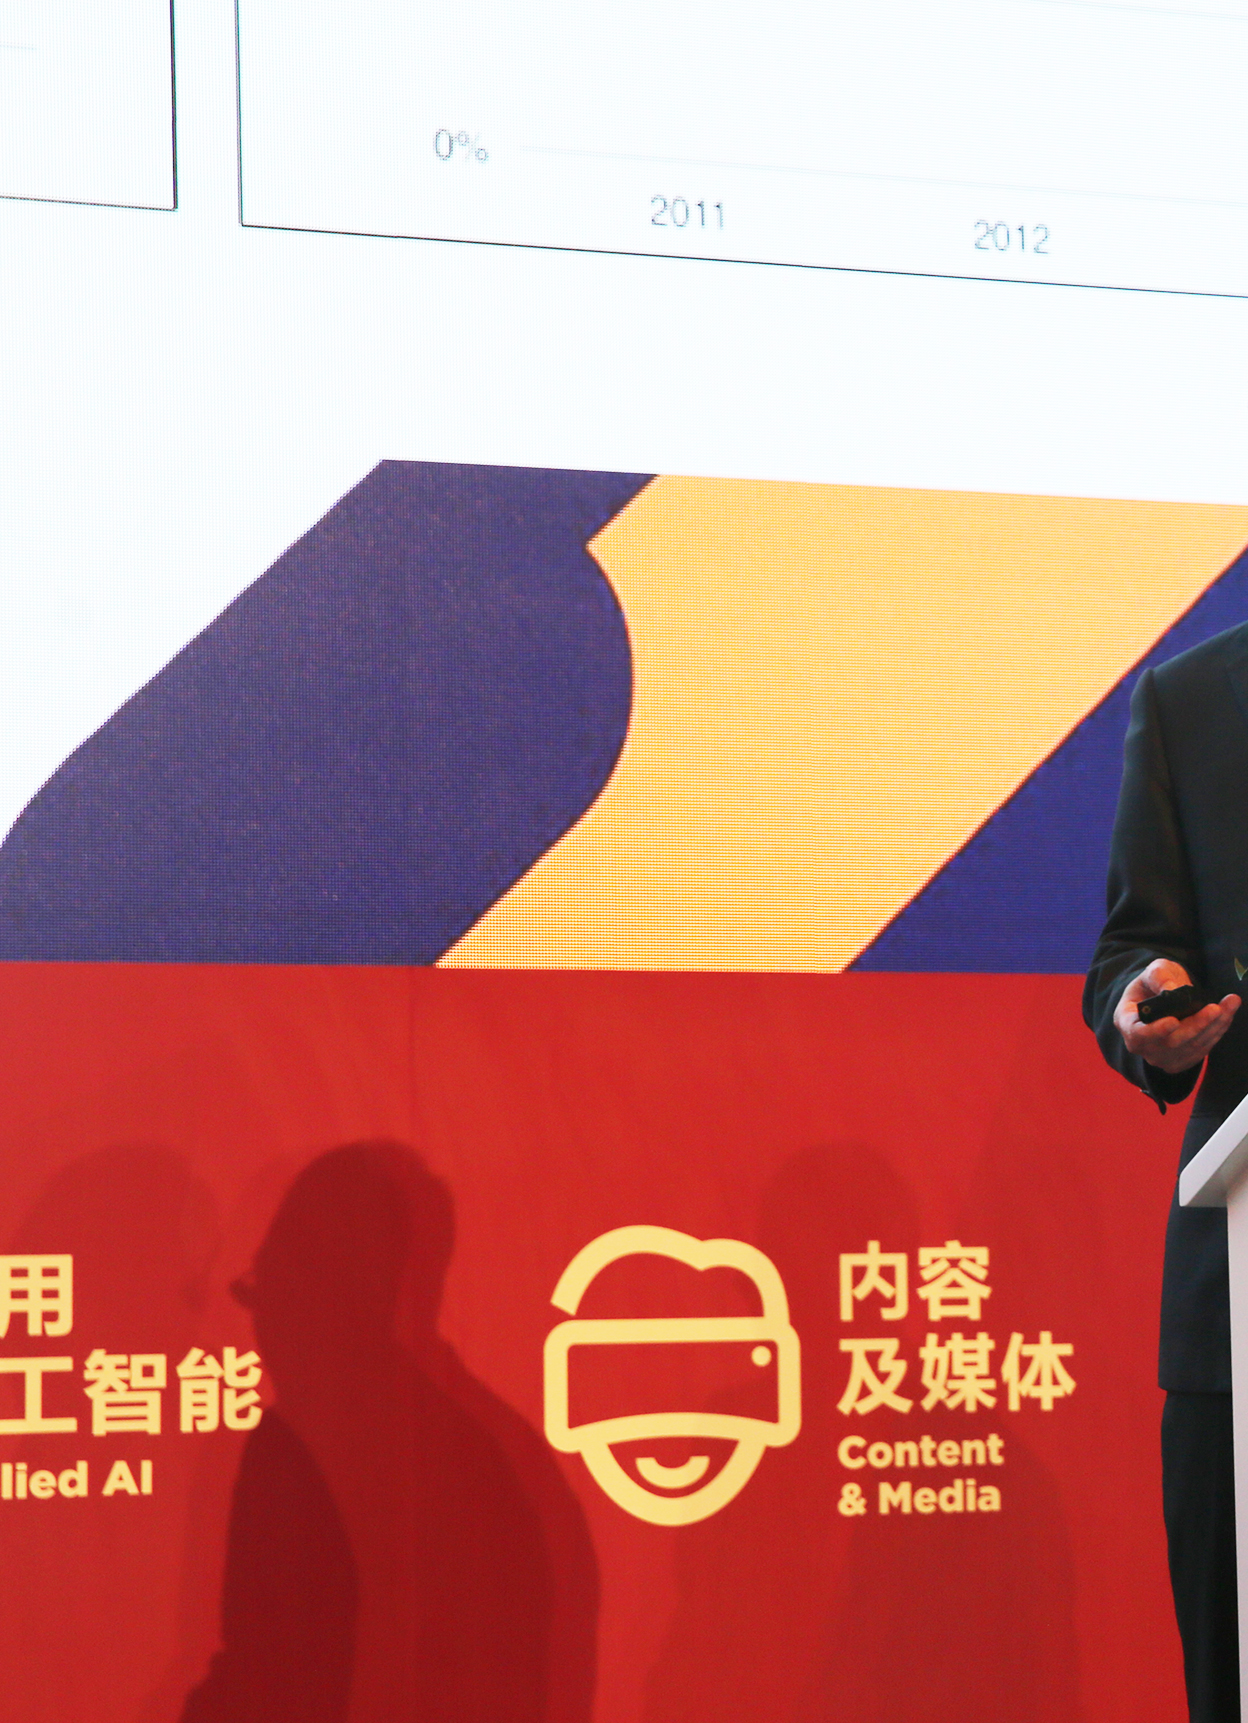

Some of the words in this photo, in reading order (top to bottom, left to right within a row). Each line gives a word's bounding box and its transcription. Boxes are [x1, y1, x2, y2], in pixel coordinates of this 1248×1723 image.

[433, 129, 491, 165] 0%
[650, 195, 726, 231] 2011
[974, 219, 1051, 257] 2012
[0, 1253, 74, 1339] 用
[838, 1239, 993, 1323] 内容
[0, 1346, 263, 1437] 工智能
[836, 1330, 1077, 1416] 及媒体
[0, 1460, 89, 1501] lied
[102, 1459, 153, 1497] AI
[837, 1433, 1005, 1470] Content
[837, 1482, 868, 1517] &
[878, 1478, 1002, 1516] Media
